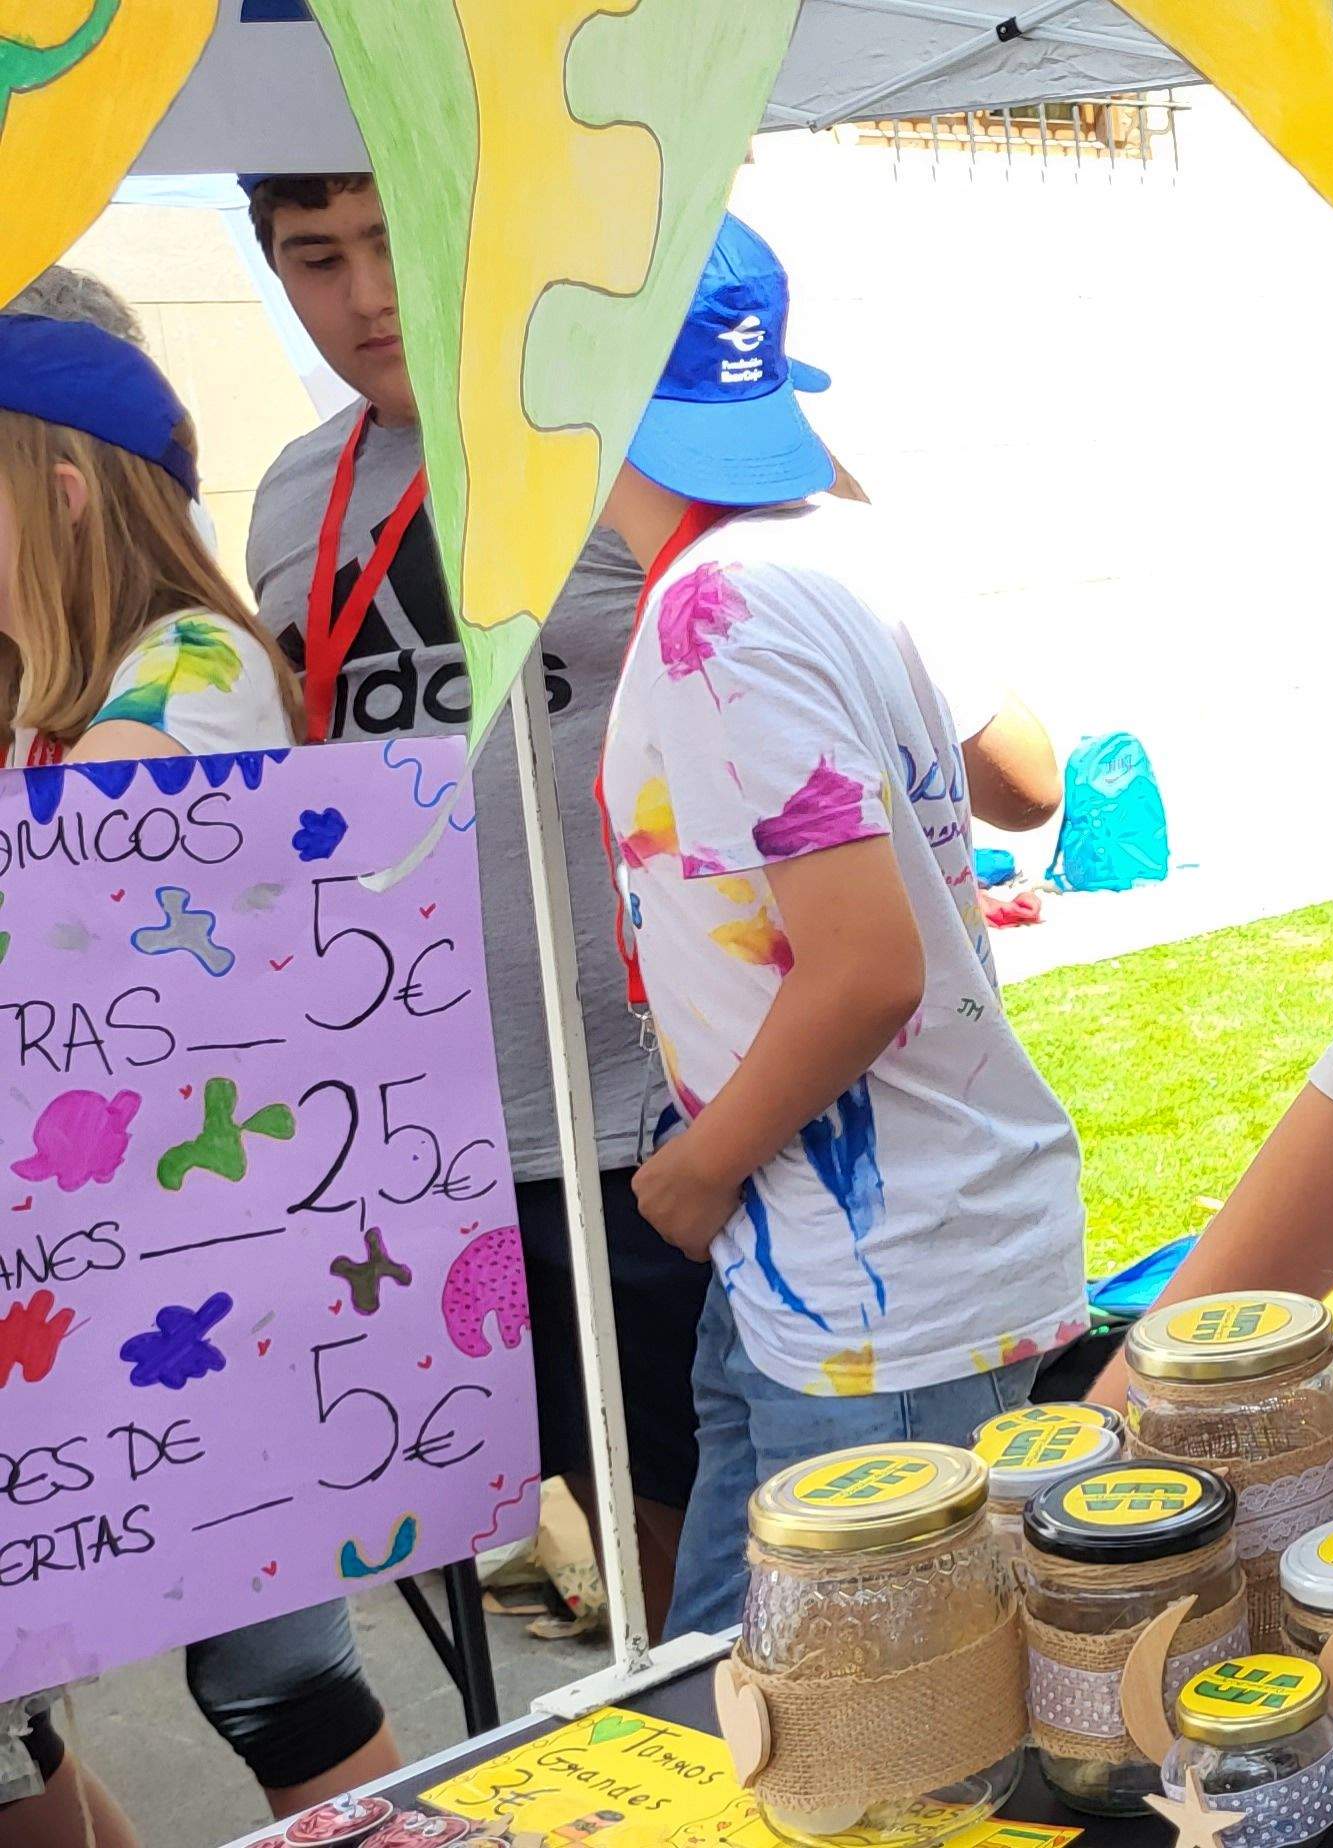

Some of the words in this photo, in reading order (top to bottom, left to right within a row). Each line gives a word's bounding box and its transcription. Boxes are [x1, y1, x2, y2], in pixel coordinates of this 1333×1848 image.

[0, 792, 244, 877] MICOS
[0, 987, 176, 1075] RAS
[107, 1419, 206, 1481] DE
[311, 1334, 493, 1490] 5€
[536, 1747, 672, 1811] Grandes
[622, 1724, 725, 1785] Tarros
